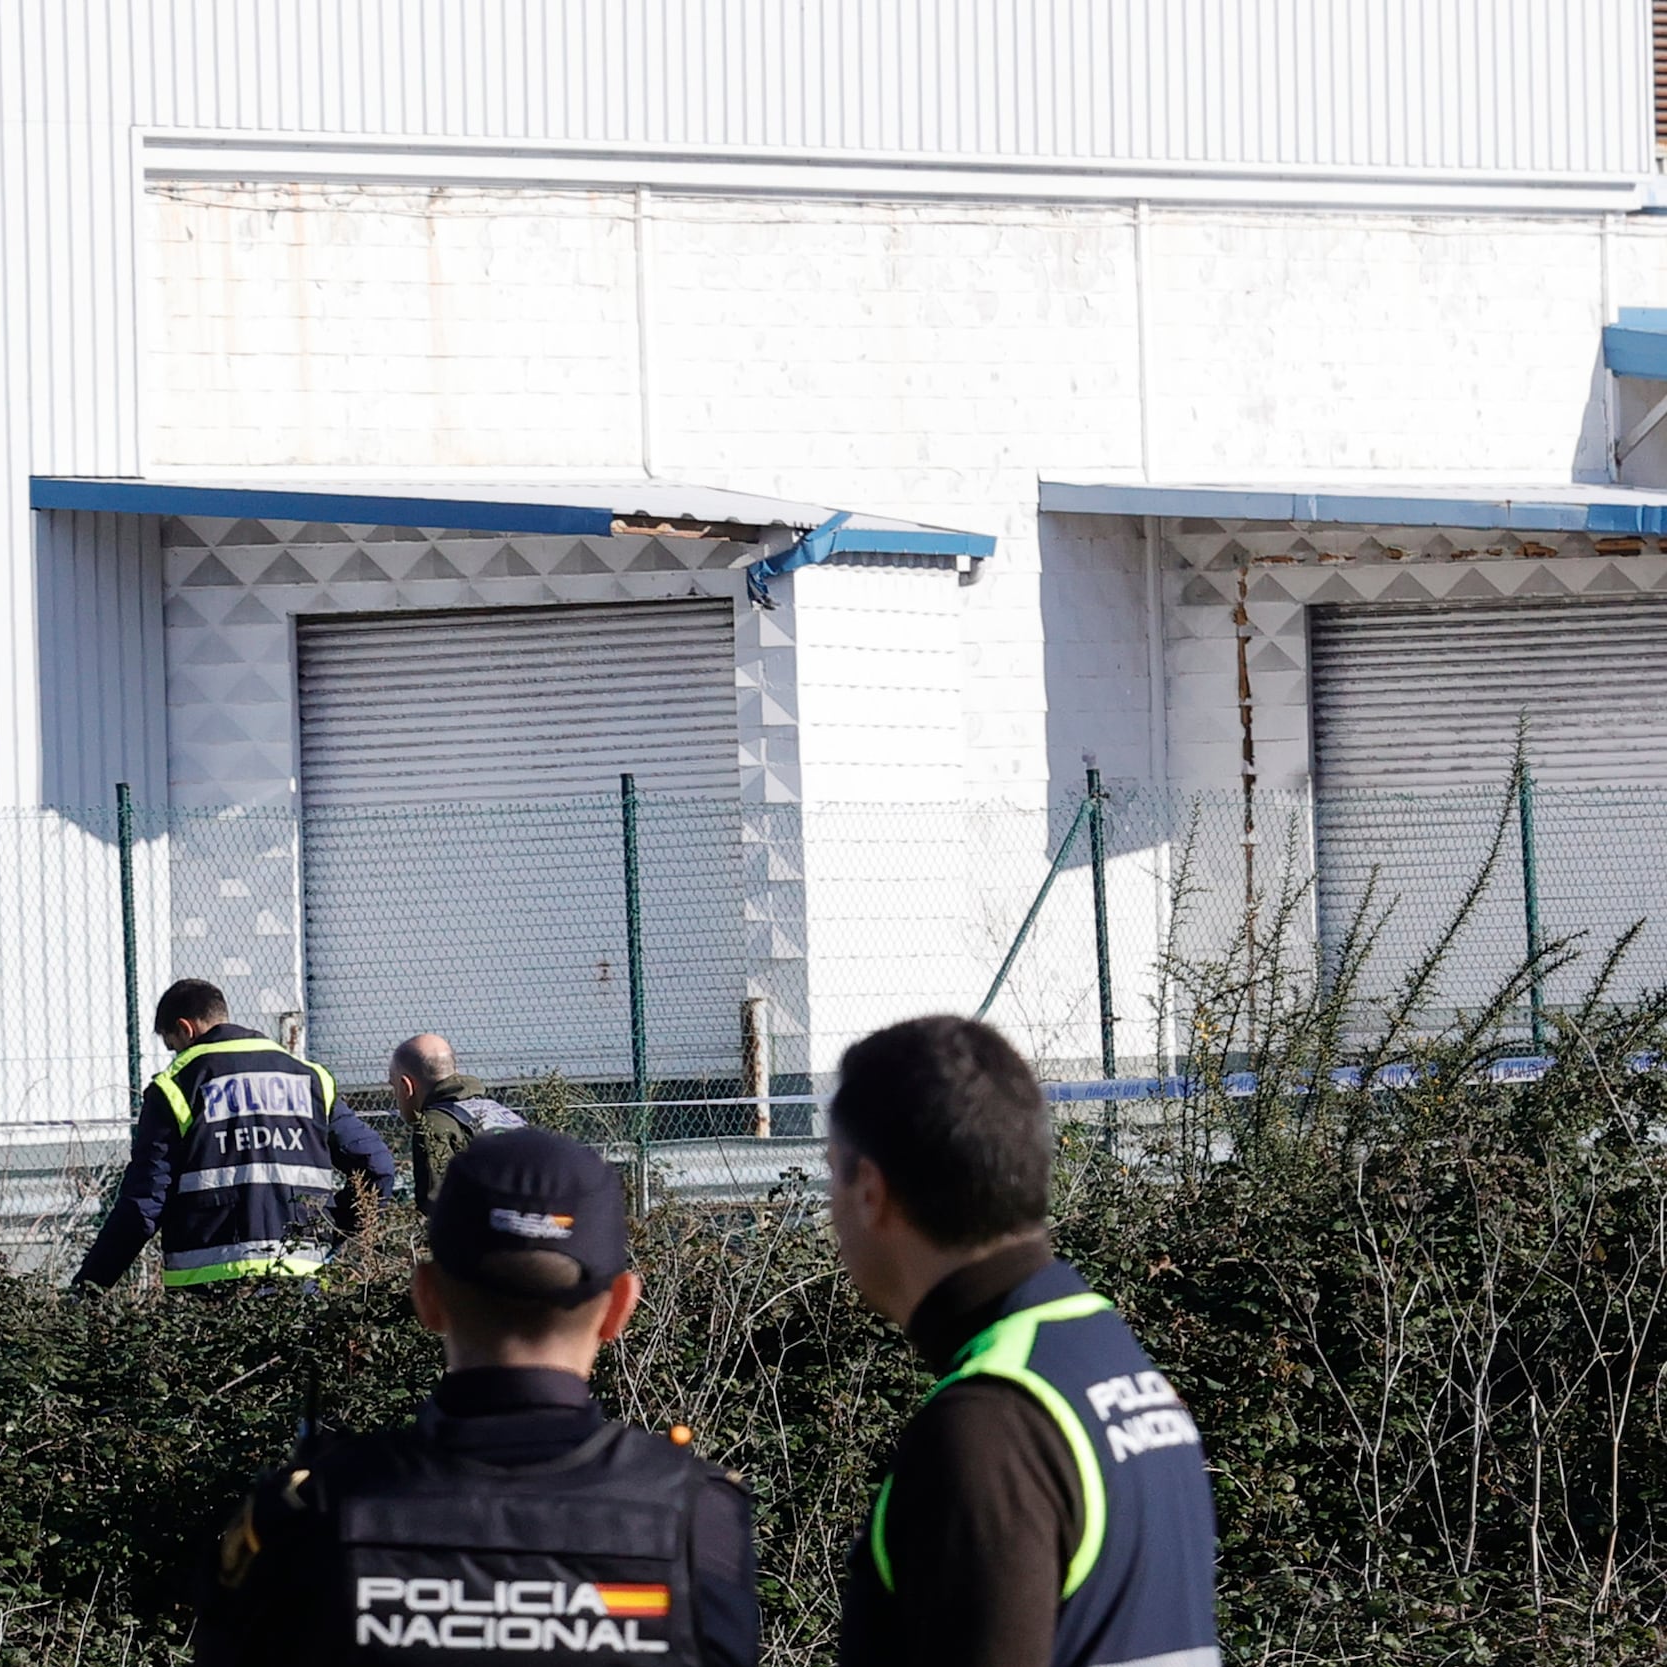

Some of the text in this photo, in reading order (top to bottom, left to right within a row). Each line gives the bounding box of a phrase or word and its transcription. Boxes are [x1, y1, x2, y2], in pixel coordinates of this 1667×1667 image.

[204, 1077, 310, 1119] POLICIA
[214, 1126, 304, 1154] TEDAX
[357, 1576, 608, 1616] POLICIA
[356, 1614, 669, 1654] NACIONAL
